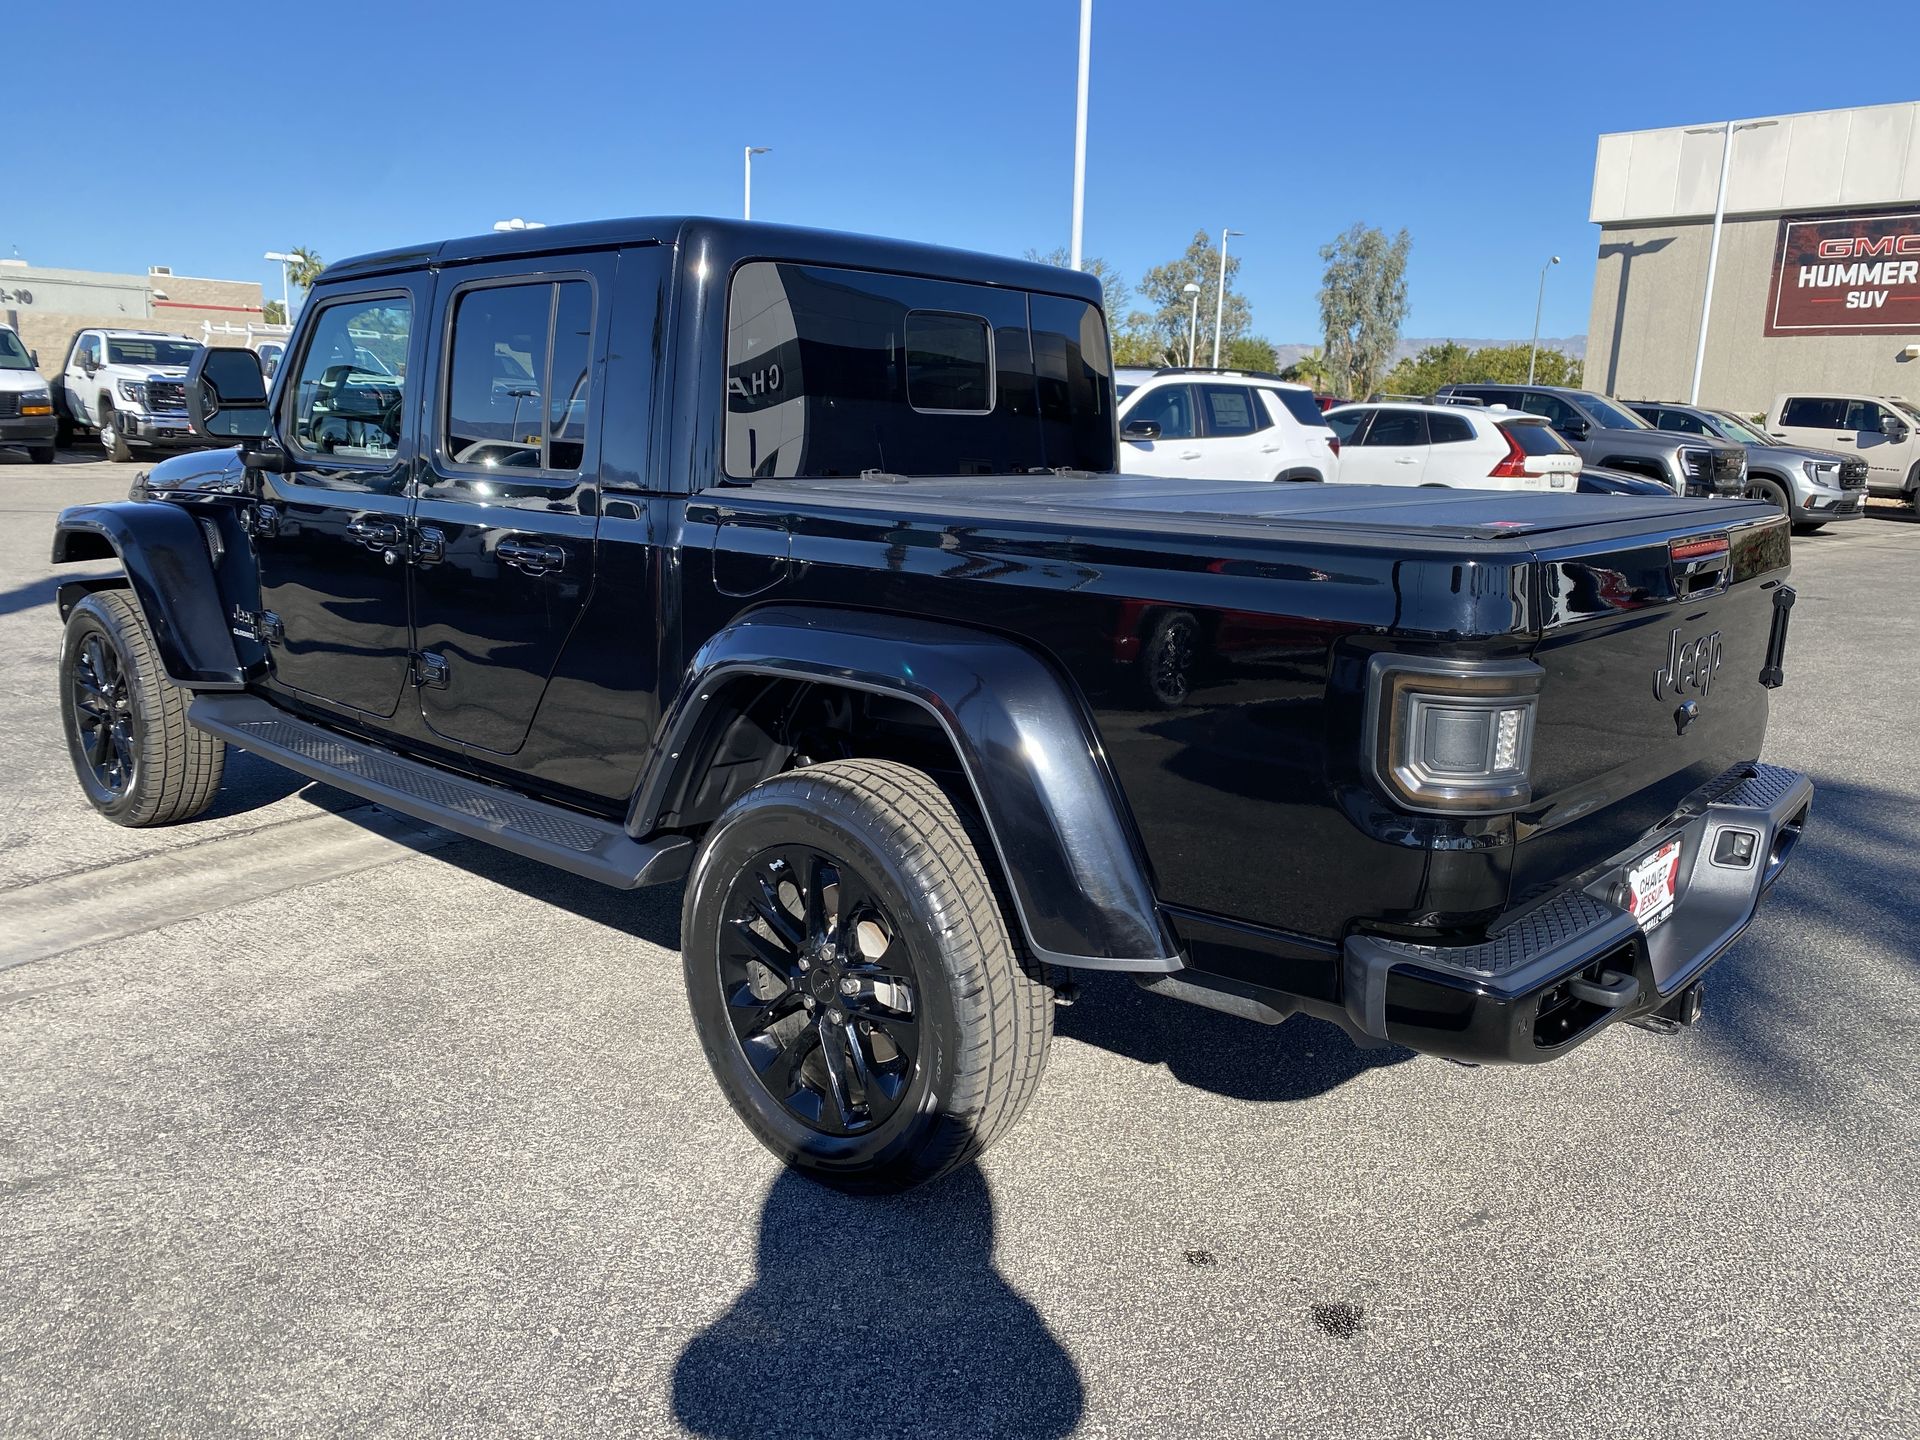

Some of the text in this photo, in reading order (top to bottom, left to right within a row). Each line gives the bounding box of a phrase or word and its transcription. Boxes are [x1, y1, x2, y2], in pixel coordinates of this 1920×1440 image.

[1818, 235, 1920, 259] GMC
[1798, 260, 1920, 288] HUMMER
[1845, 290, 1889, 309] SUV
[1652, 627, 1723, 702] Jeep
[1639, 863, 1668, 895] CHAVEZ
